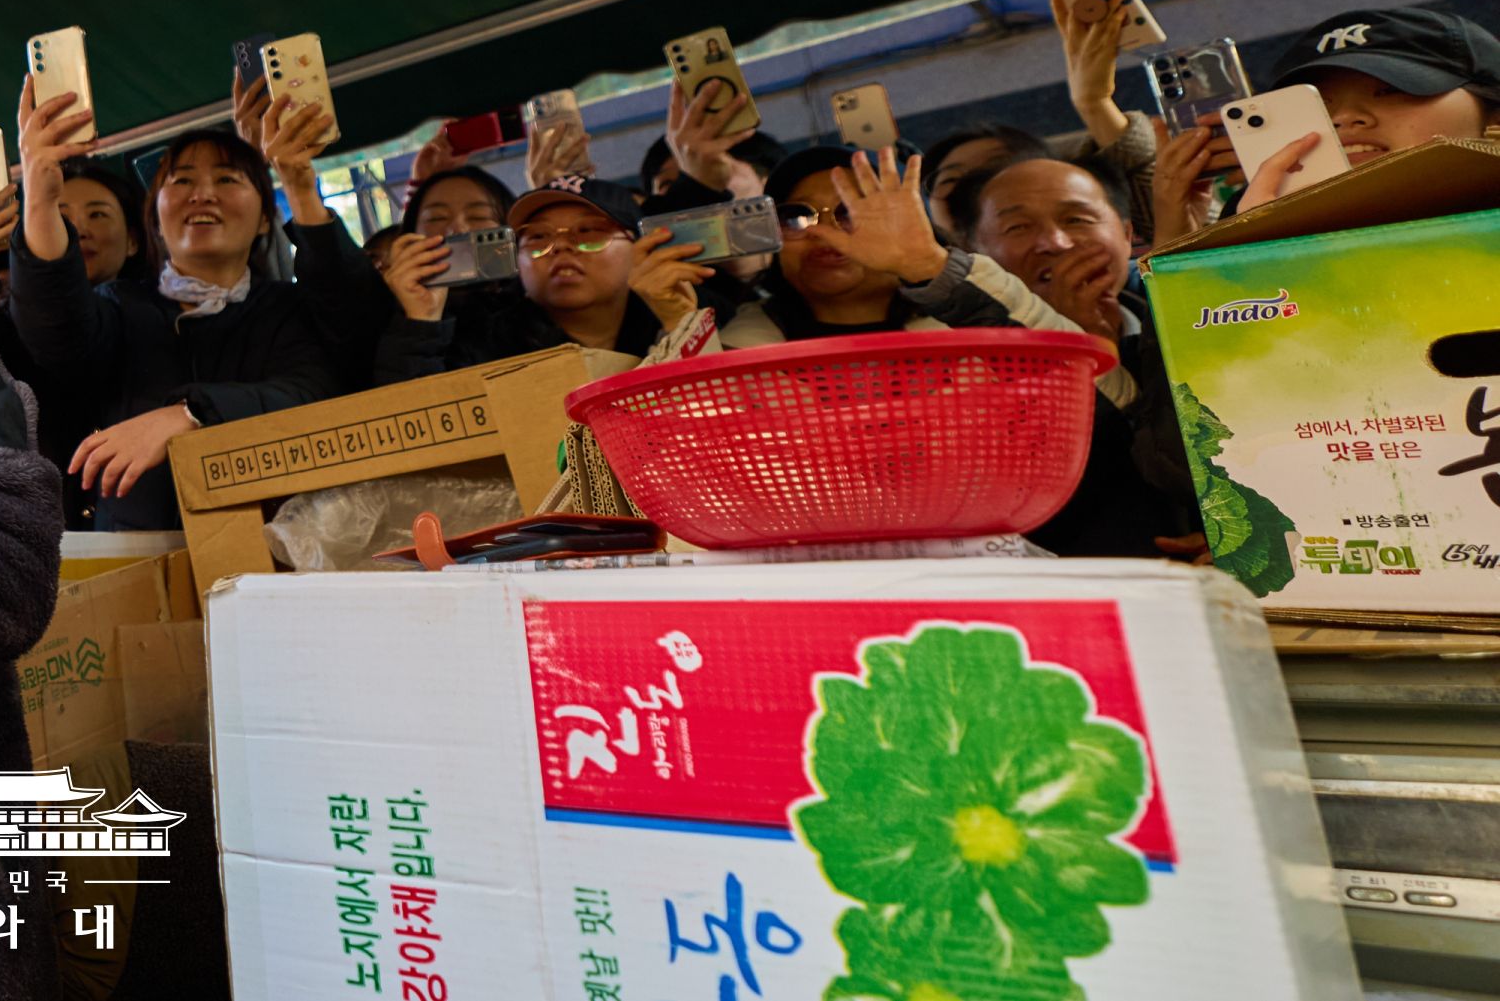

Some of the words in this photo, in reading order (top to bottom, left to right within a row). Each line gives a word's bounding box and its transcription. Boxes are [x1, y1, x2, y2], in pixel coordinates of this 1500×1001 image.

[1194, 304, 1279, 328] Jindo
[441, 413, 454, 433] 9
[472, 406, 486, 426] 8
[1294, 419, 1359, 439] 섬에서,
[1361, 413, 1447, 434] 차별화된
[376, 425, 395, 446] 11
[404, 419, 426, 440] 10
[316, 438, 337, 459] 13
[344, 431, 366, 452] 12
[1326, 440, 1375, 462] 맛을
[1379, 440, 1422, 460] 담은
[262, 450, 282, 470] 15
[289, 444, 309, 464] 14
[209, 462, 229, 480] 18
[236, 456, 254, 476] 16
[1356, 513, 1430, 528] 방송출연
[1300, 539, 1417, 574] 투데이
[1441, 543, 1490, 563] 6시
[647, 711, 674, 780] 아리랑
[328, 794, 371, 855] 자란
[574, 887, 615, 935] 맛!!
[335, 865, 382, 994] 노지에서
[663, 871, 803, 1001] 동
